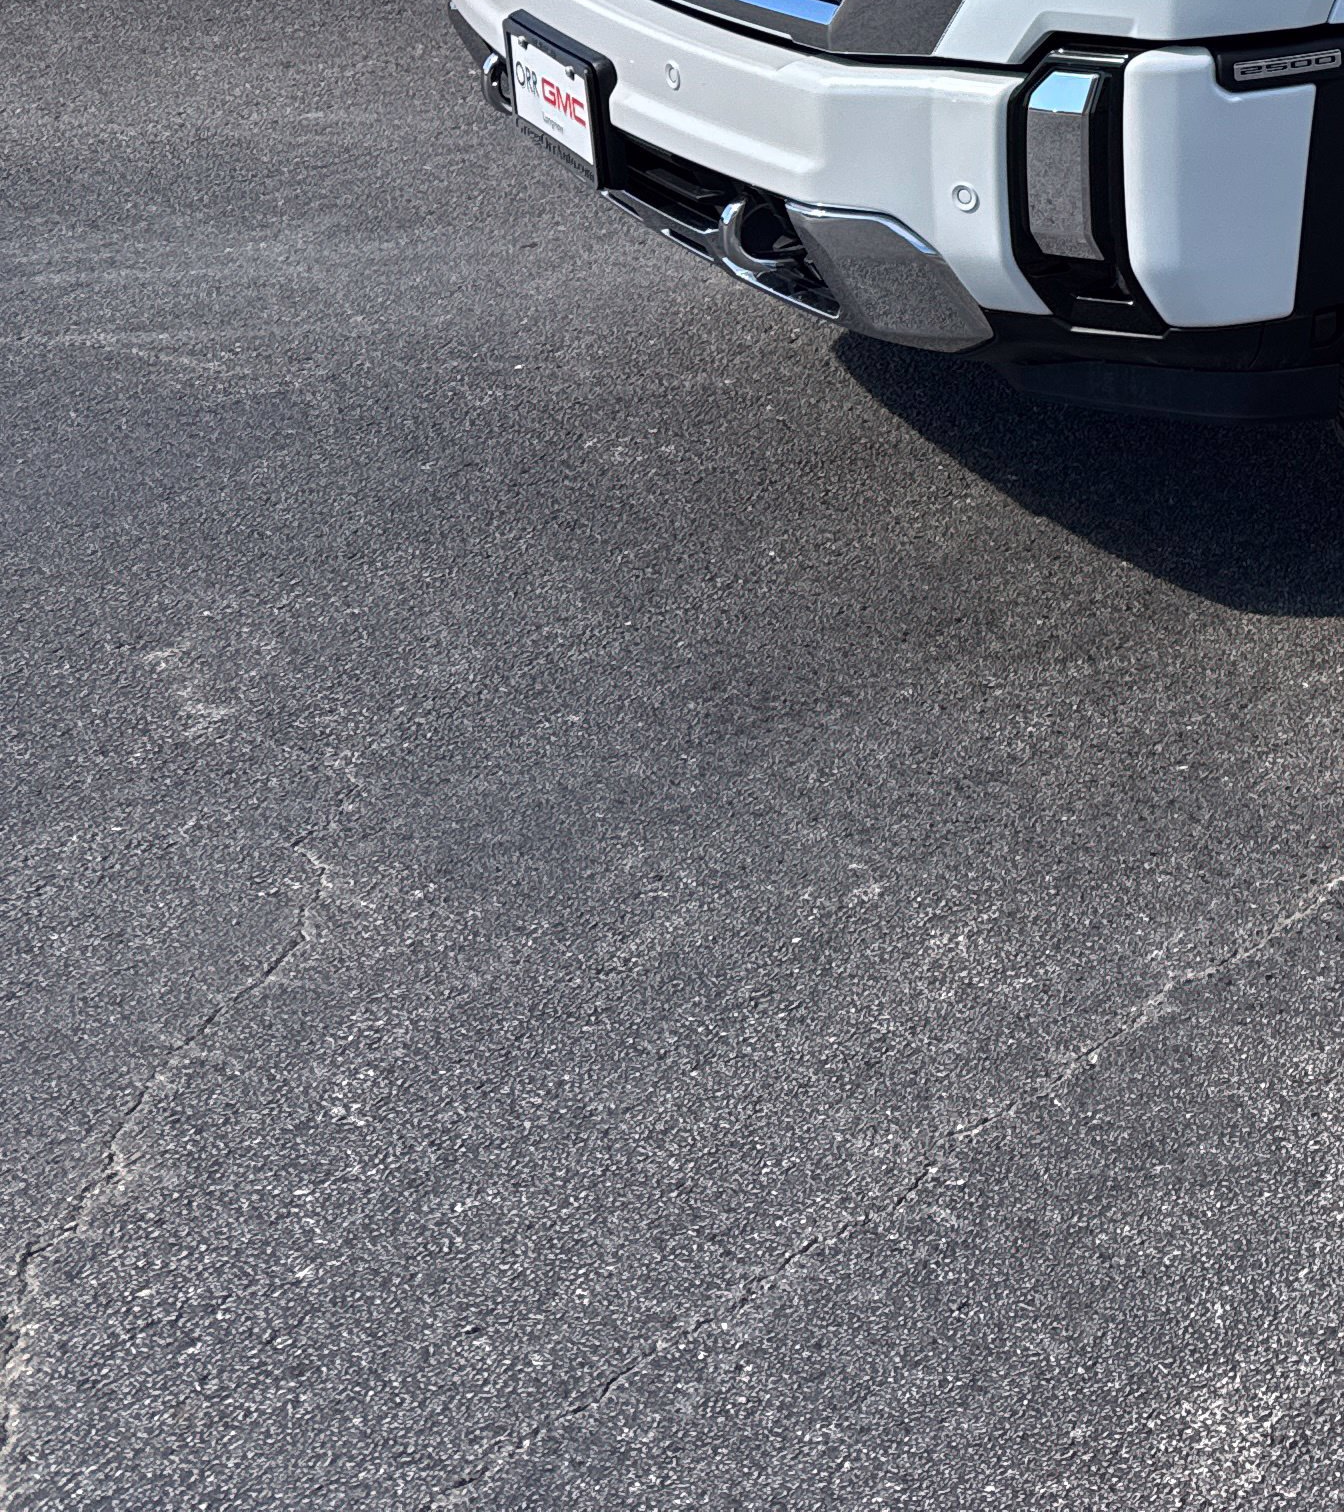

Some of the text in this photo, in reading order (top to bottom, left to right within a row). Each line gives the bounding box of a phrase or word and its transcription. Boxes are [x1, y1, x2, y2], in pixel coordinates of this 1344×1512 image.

[1240, 55, 1336, 76] 2500
[516, 61, 586, 128] ORR GMC
